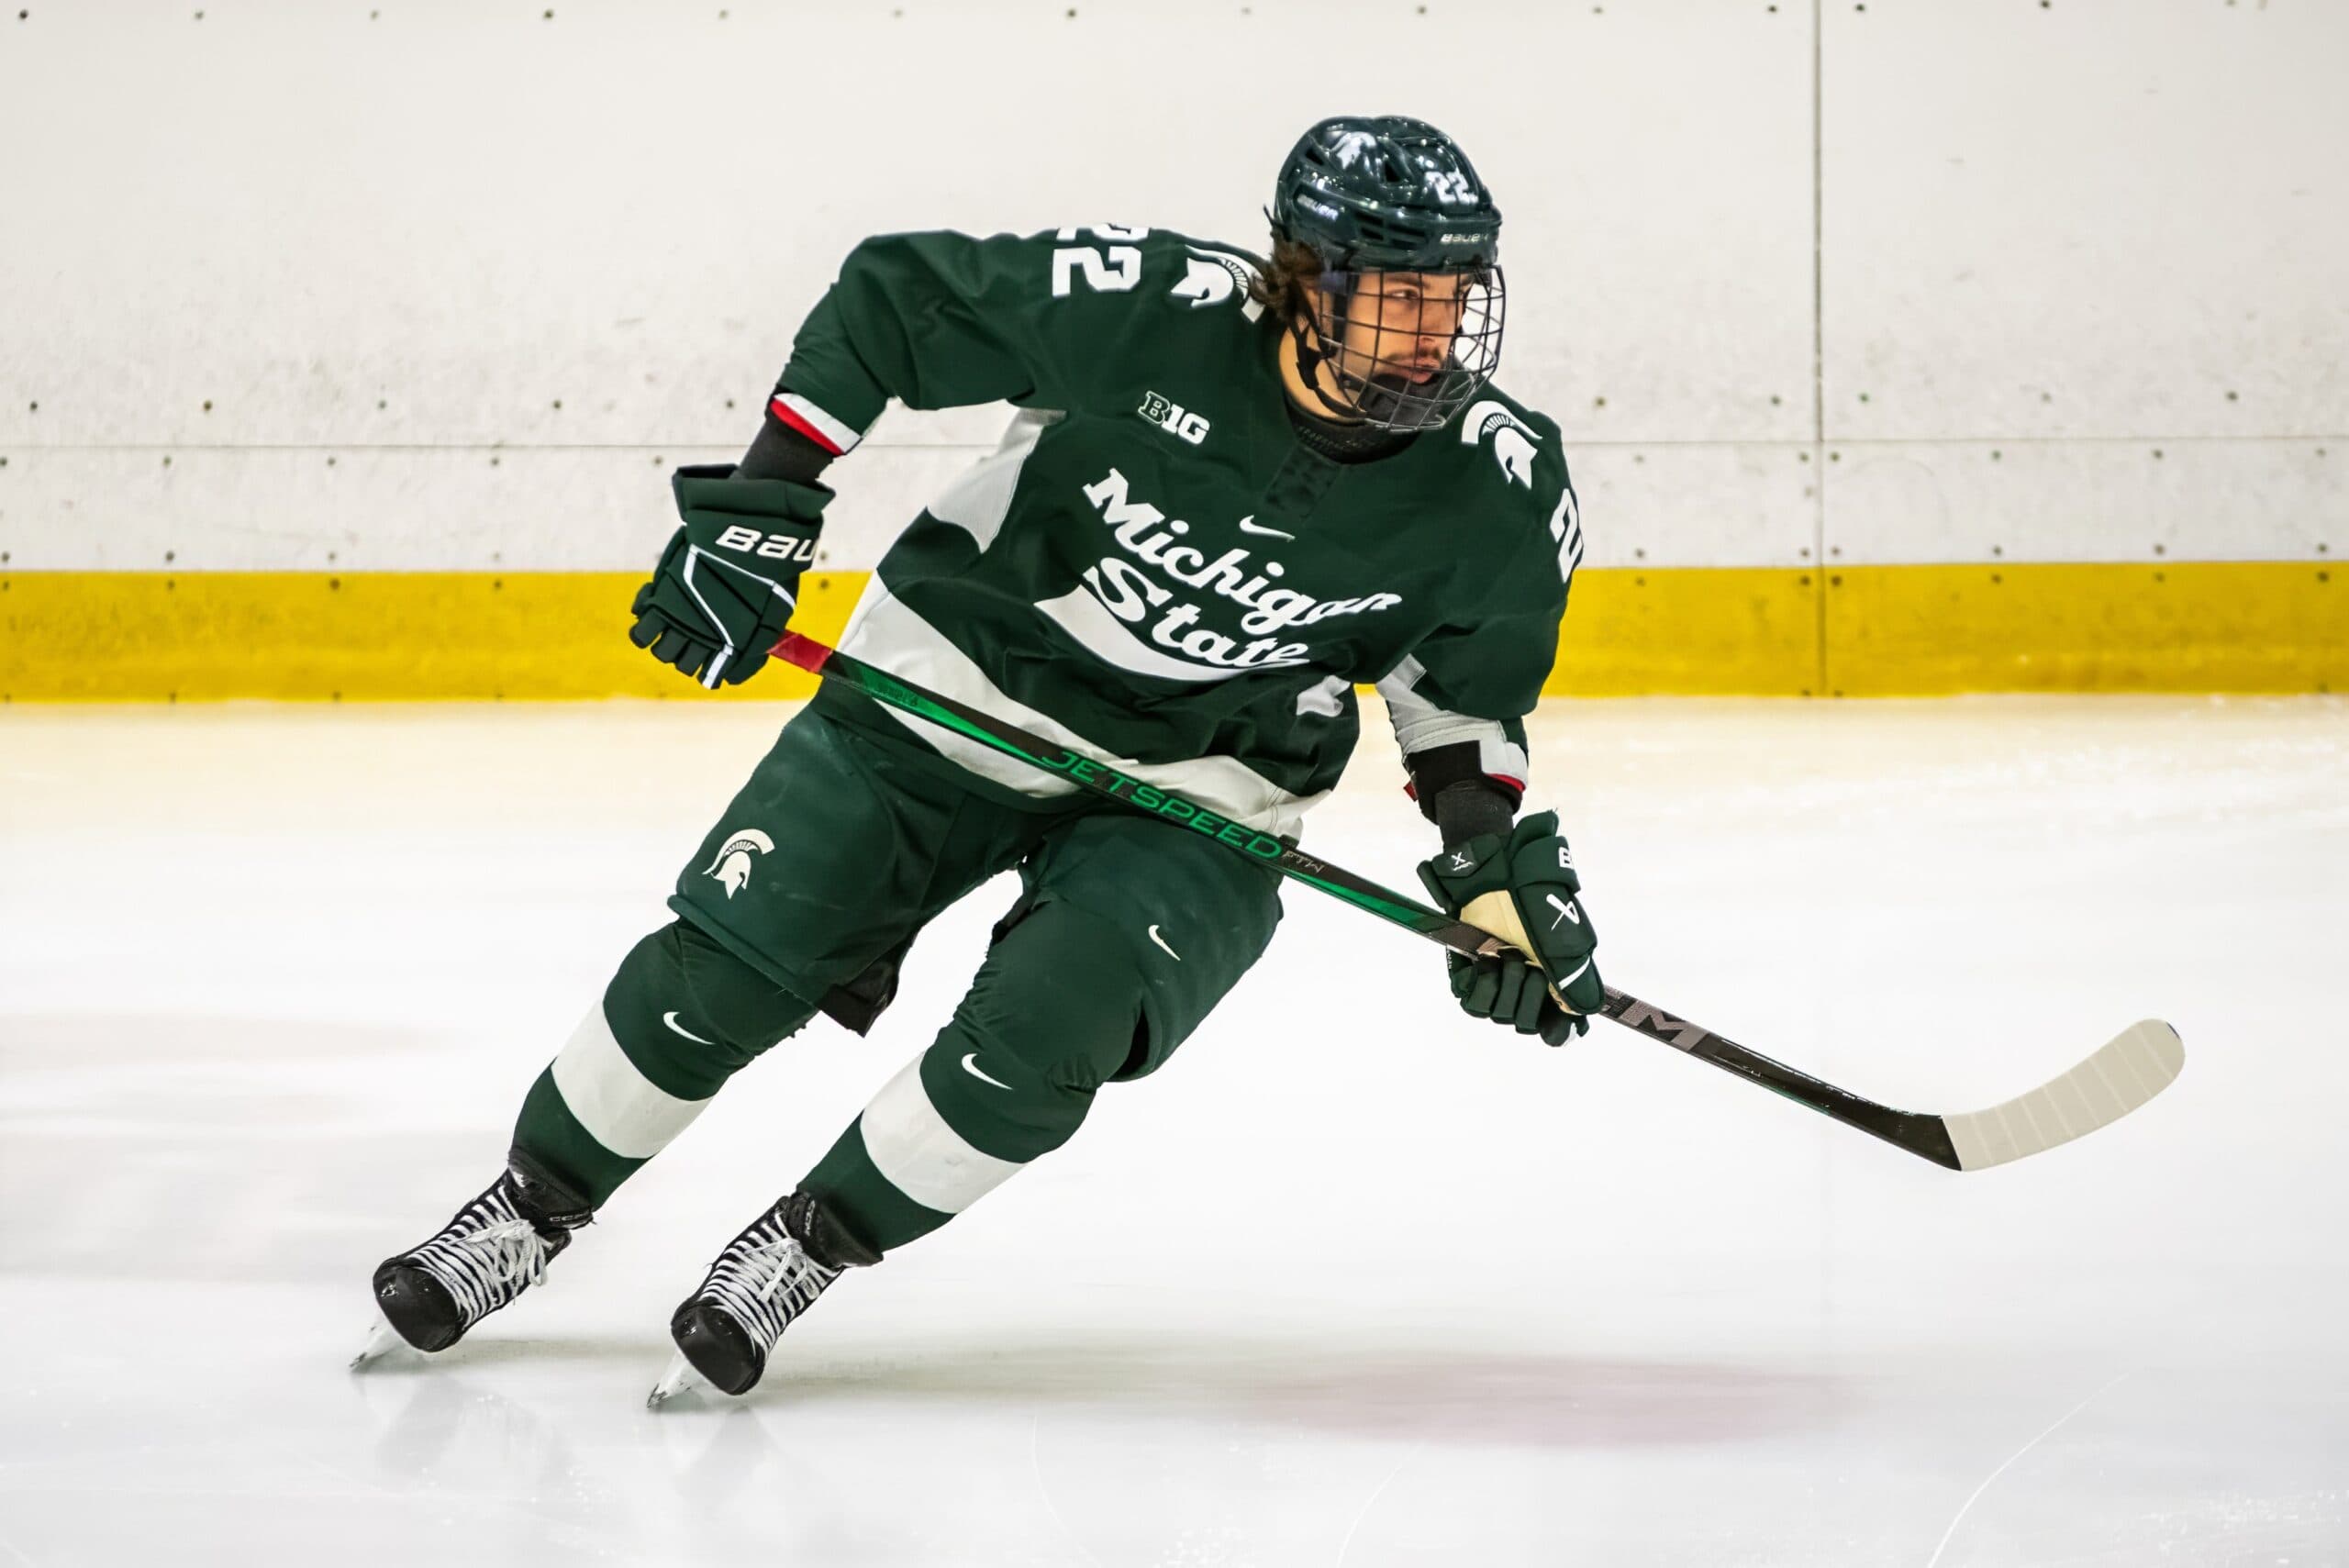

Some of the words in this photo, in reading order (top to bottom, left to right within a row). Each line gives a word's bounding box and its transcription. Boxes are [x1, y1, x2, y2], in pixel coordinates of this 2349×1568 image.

[1425, 172, 1478, 203] 22
[1083, 467, 1402, 635] Michigan
[1083, 557, 1309, 667] State
[1041, 751, 1282, 860] JETSPEED
